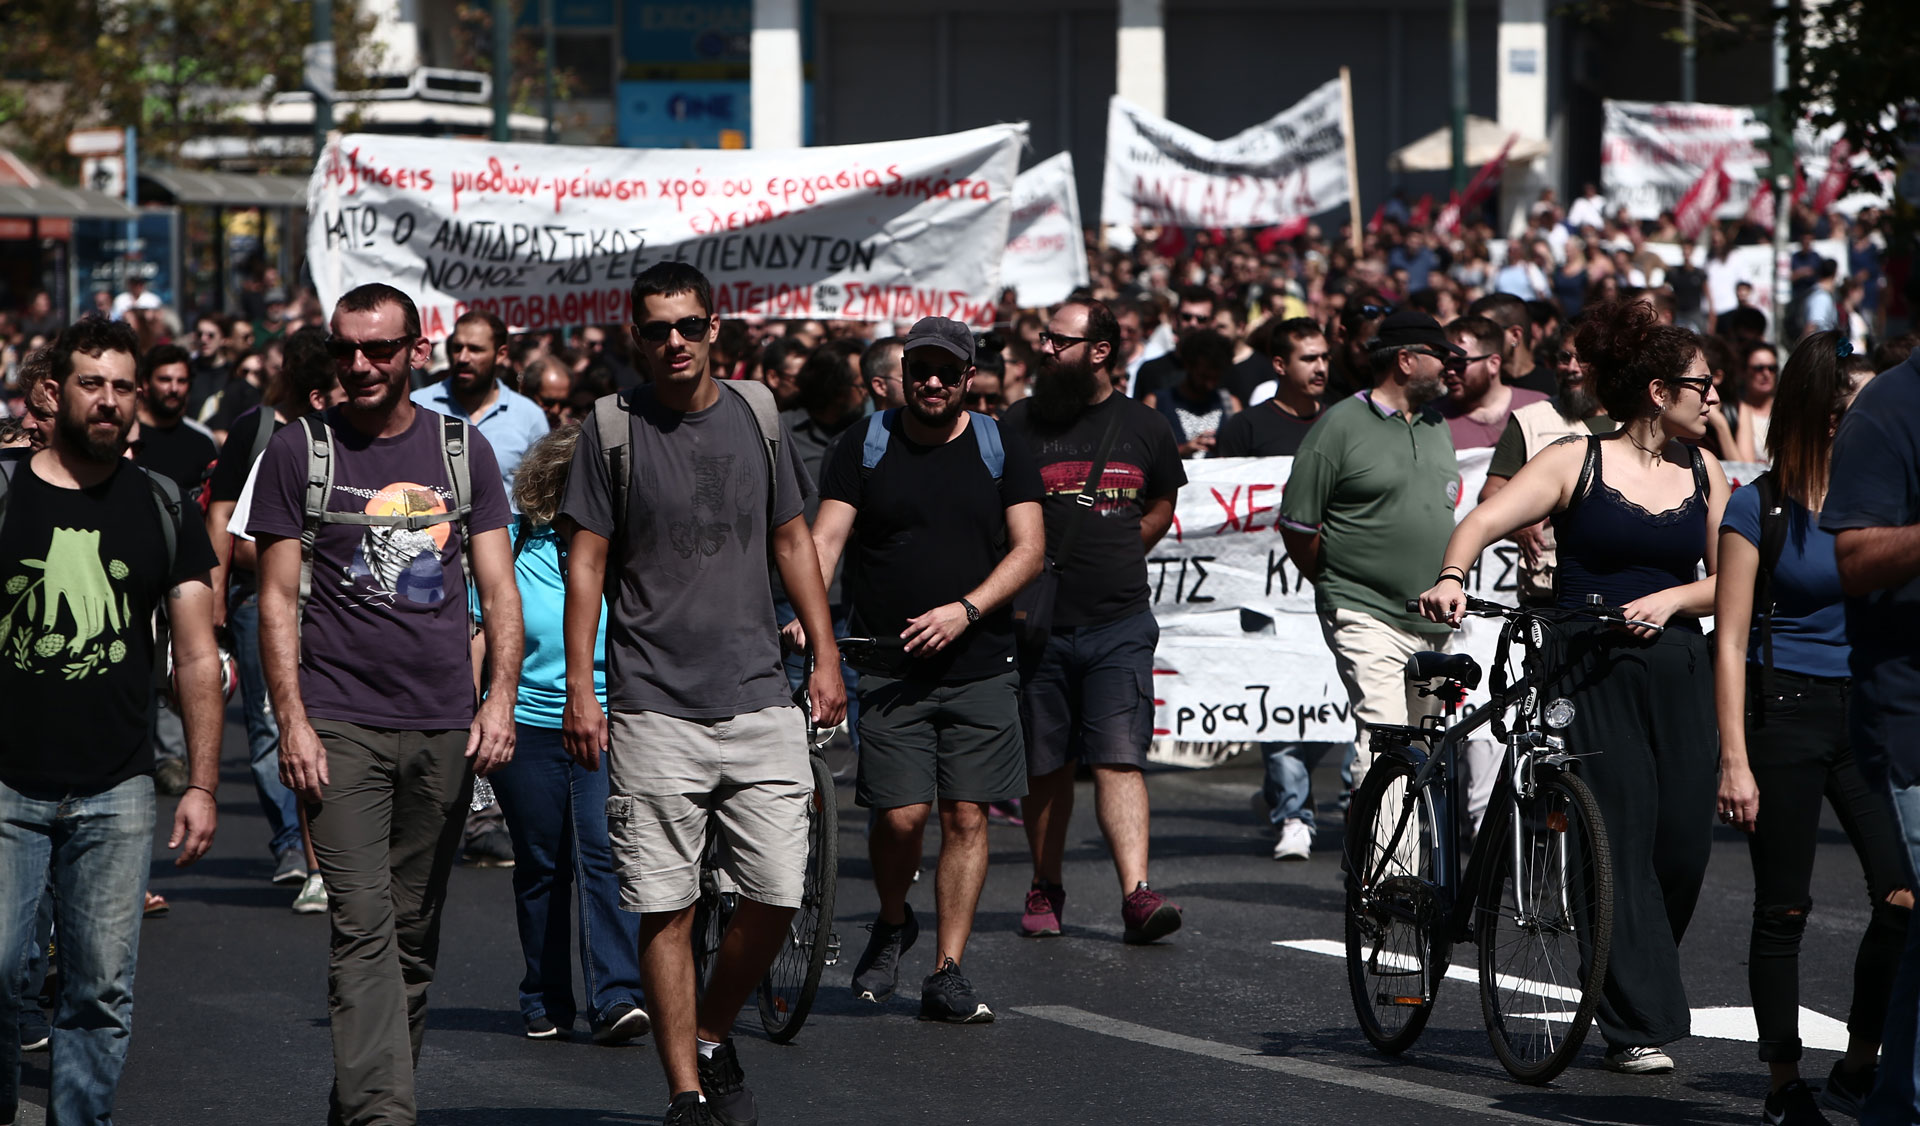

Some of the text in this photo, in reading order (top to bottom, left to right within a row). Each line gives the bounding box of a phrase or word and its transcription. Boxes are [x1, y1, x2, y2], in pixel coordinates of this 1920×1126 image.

[657, 165, 752, 212] χρόου
[324, 205, 378, 250] ΚΑΤΩ
[393, 211, 416, 245] Ο
[421, 256, 533, 293] ΝΟΜΟΣ
